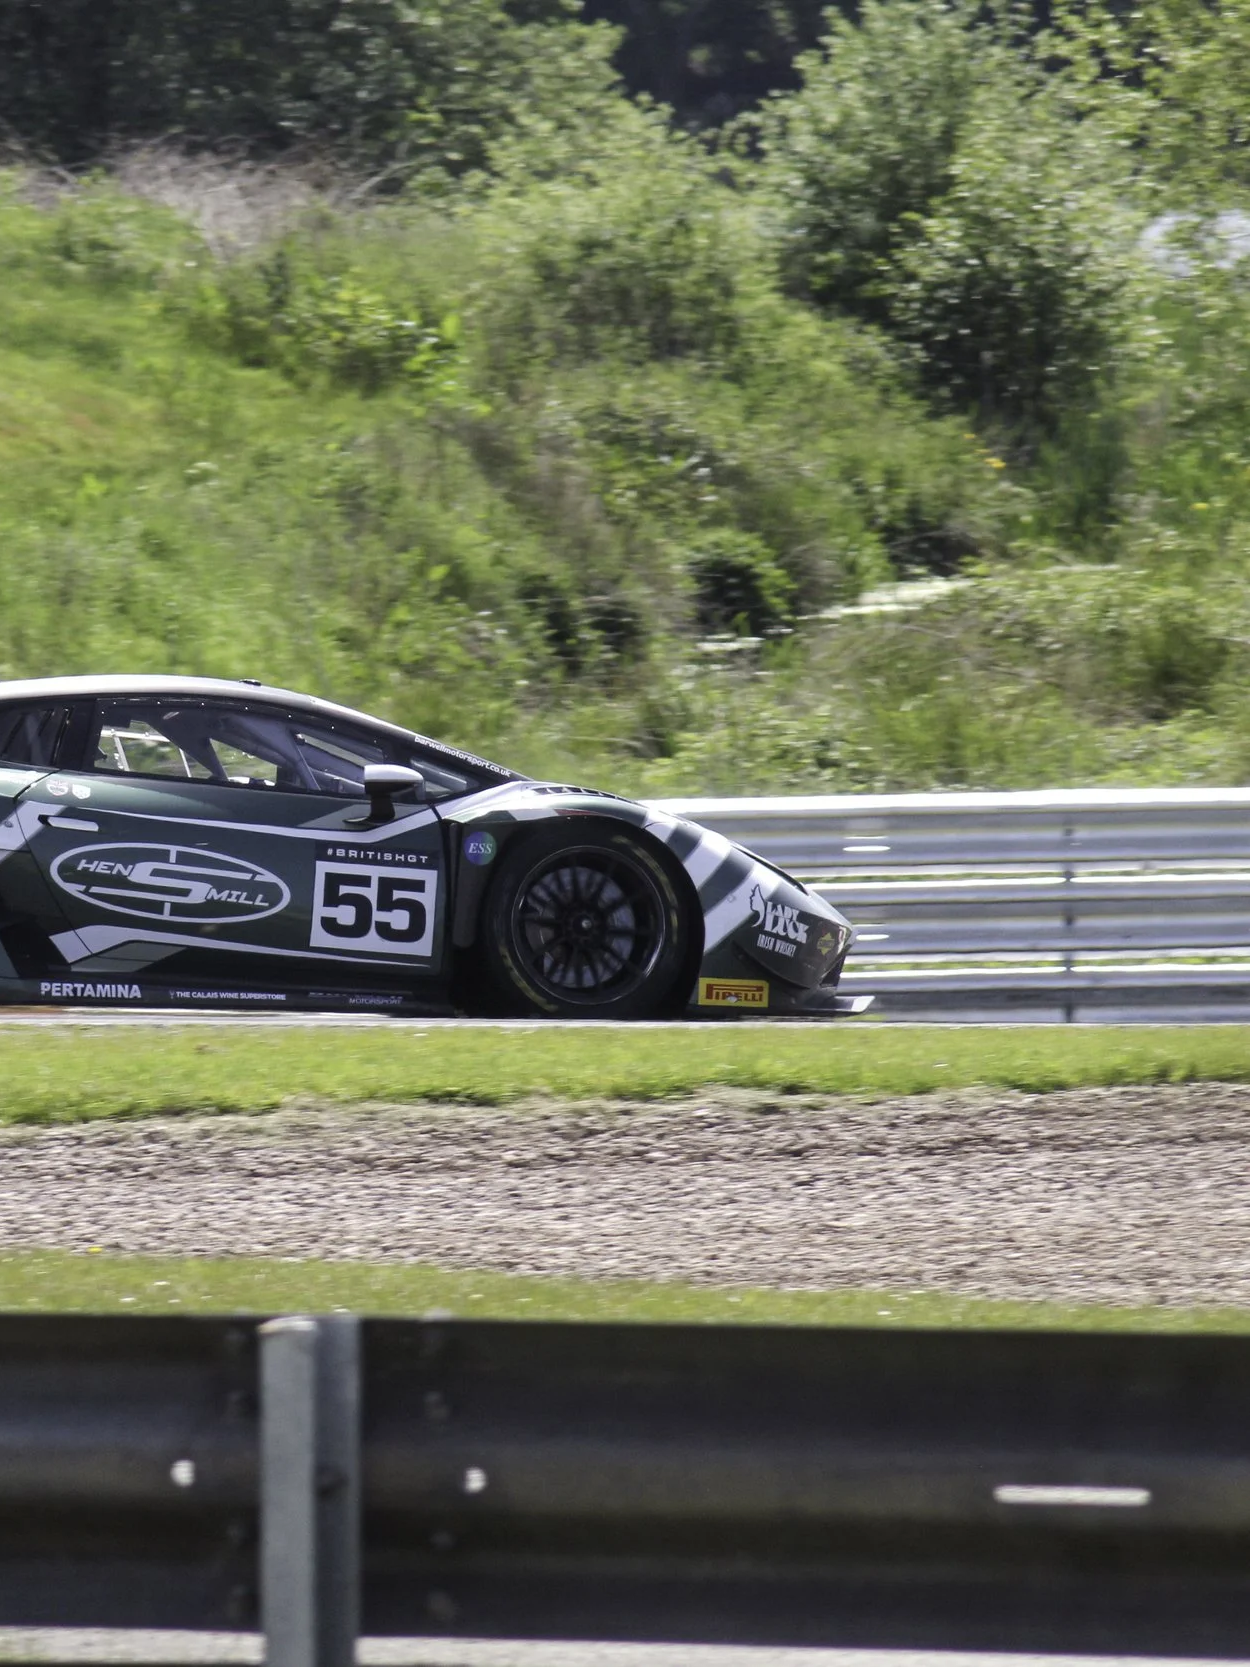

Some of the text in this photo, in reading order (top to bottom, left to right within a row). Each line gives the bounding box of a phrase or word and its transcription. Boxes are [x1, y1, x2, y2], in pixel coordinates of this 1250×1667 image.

[414, 735, 511, 778] barwellmotorsport.co.uk
[327, 848, 429, 864] #BRITISHGT
[468, 842, 493, 854] ESS
[76, 859, 135, 876] HEN
[205, 887, 270, 907] MILL
[320, 871, 427, 944] 55
[764, 911, 810, 944] LUCK
[756, 933, 775, 951] IRISH
[40, 982, 142, 999] PERTAMINA
[191, 991, 219, 999] CALAIS
[240, 992, 287, 1001] SUPERSTORE
[705, 983, 764, 1002] PIRELLI
